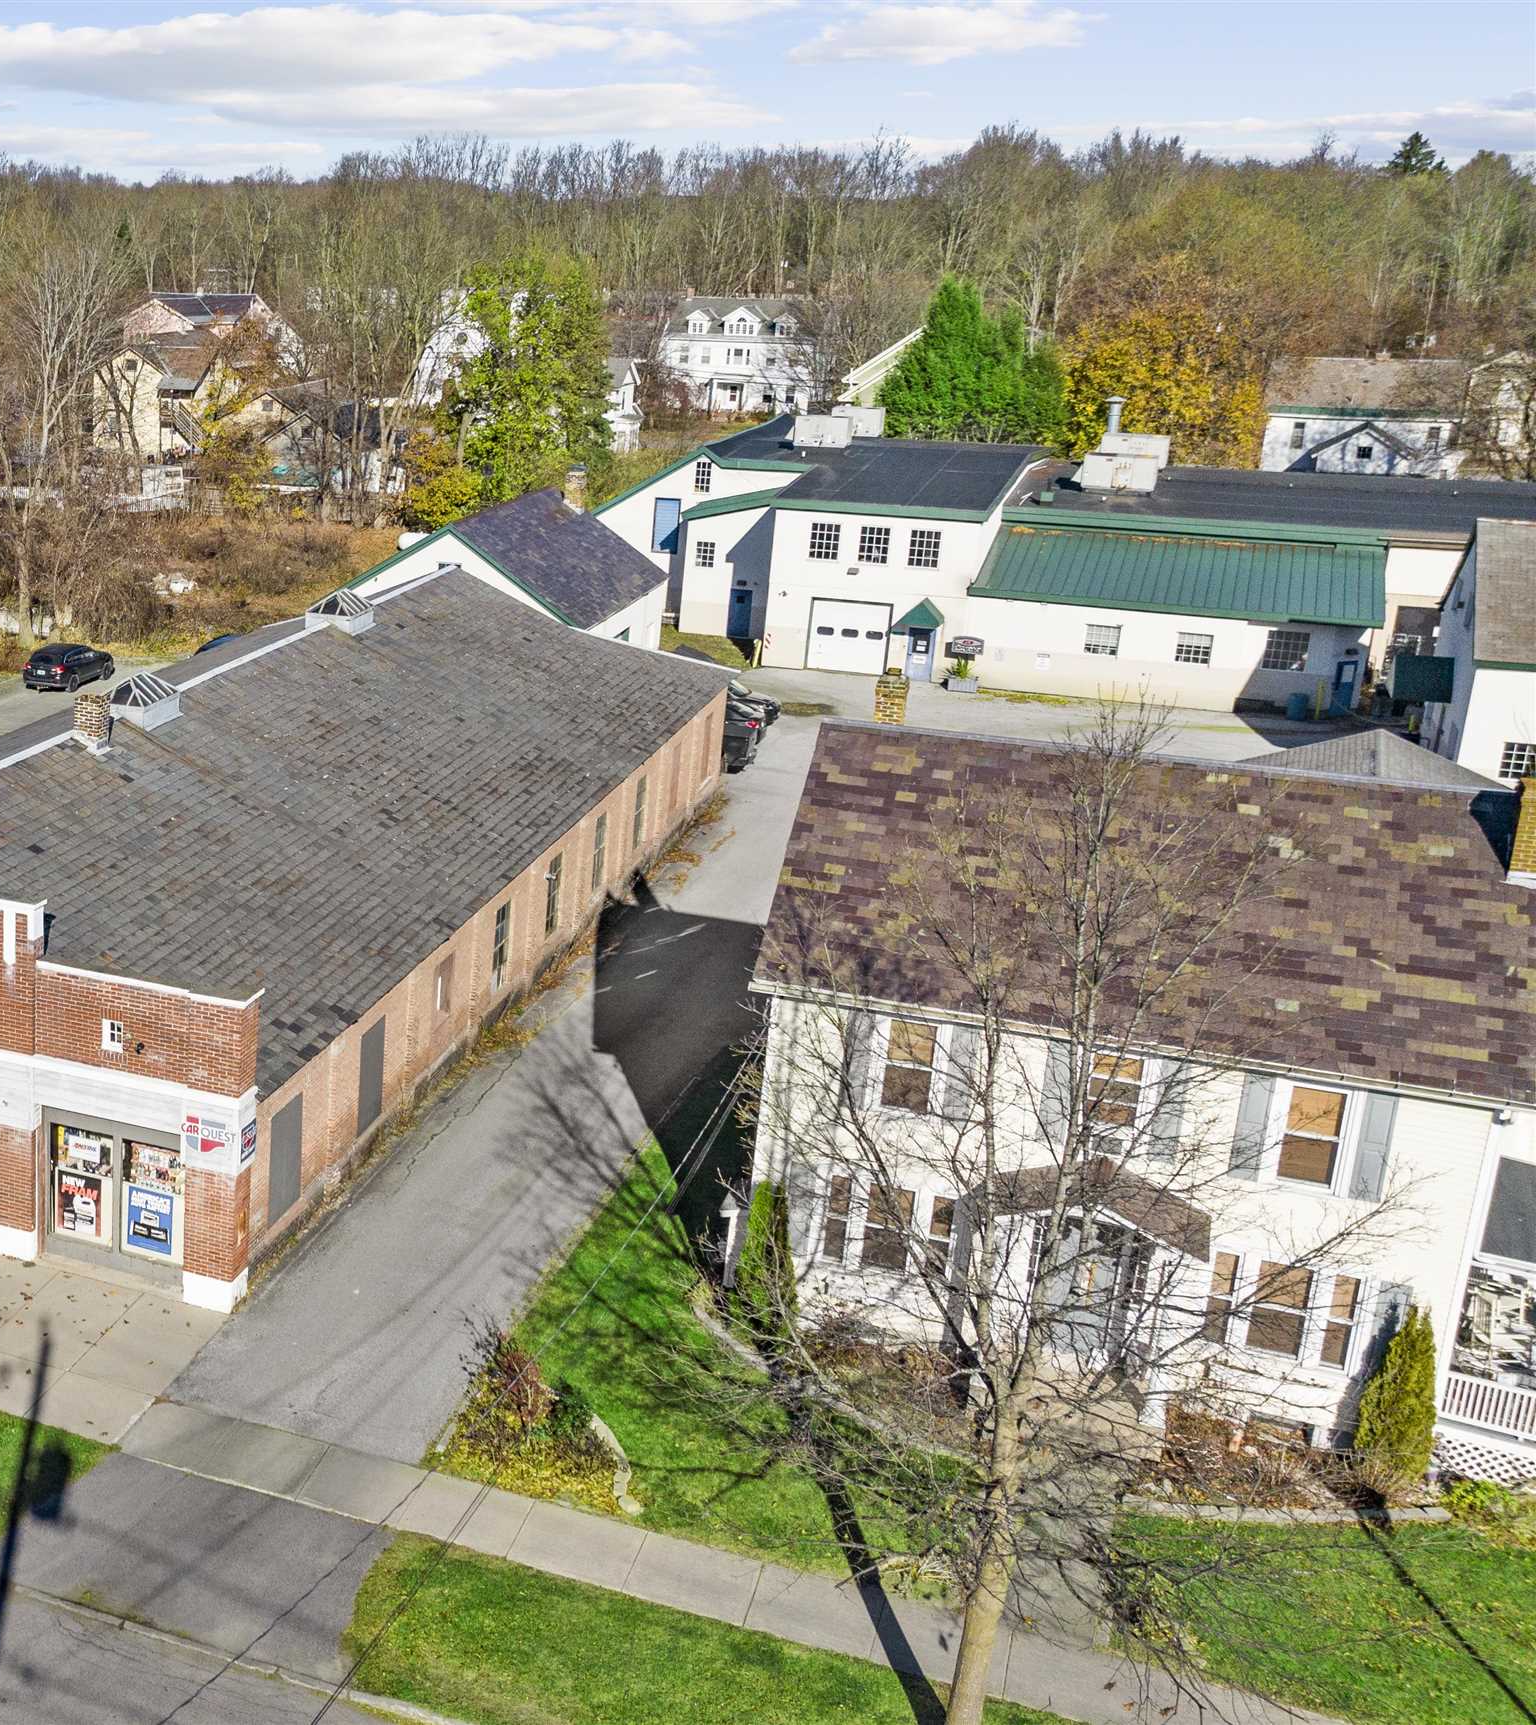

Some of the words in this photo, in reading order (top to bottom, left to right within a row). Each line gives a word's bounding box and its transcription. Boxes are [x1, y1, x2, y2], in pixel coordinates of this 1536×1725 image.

[181, 1122, 236, 1144] CARQUEST
[62, 1174, 85, 1187] NEW
[61, 1184, 98, 1200] FRAM
